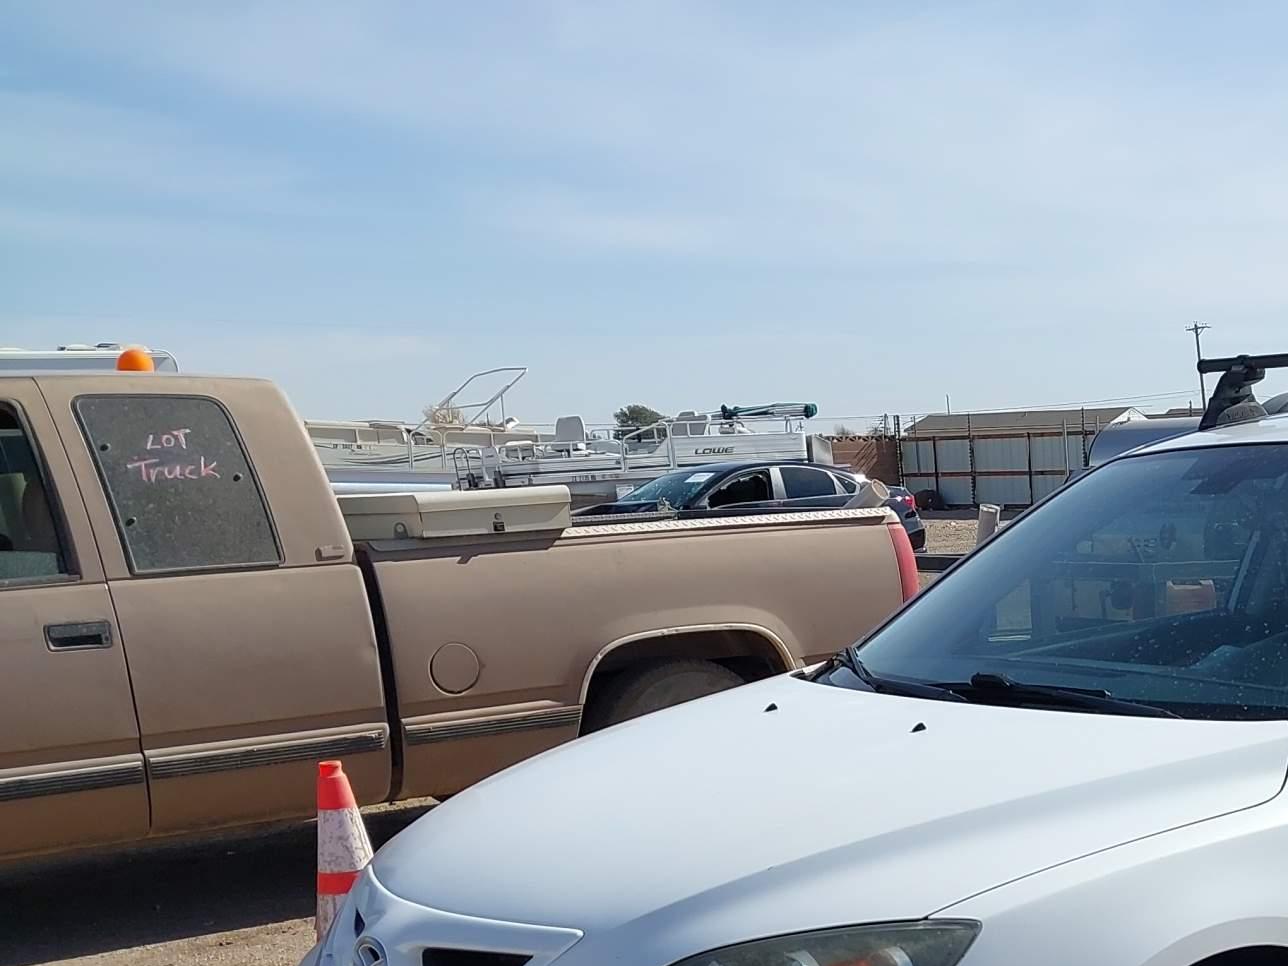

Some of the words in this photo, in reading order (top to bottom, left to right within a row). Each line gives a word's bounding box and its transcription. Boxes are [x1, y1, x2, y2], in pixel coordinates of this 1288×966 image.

[146, 428, 192, 450] LOT
[694, 446, 736, 455] LOWE
[126, 455, 221, 484] Truck
